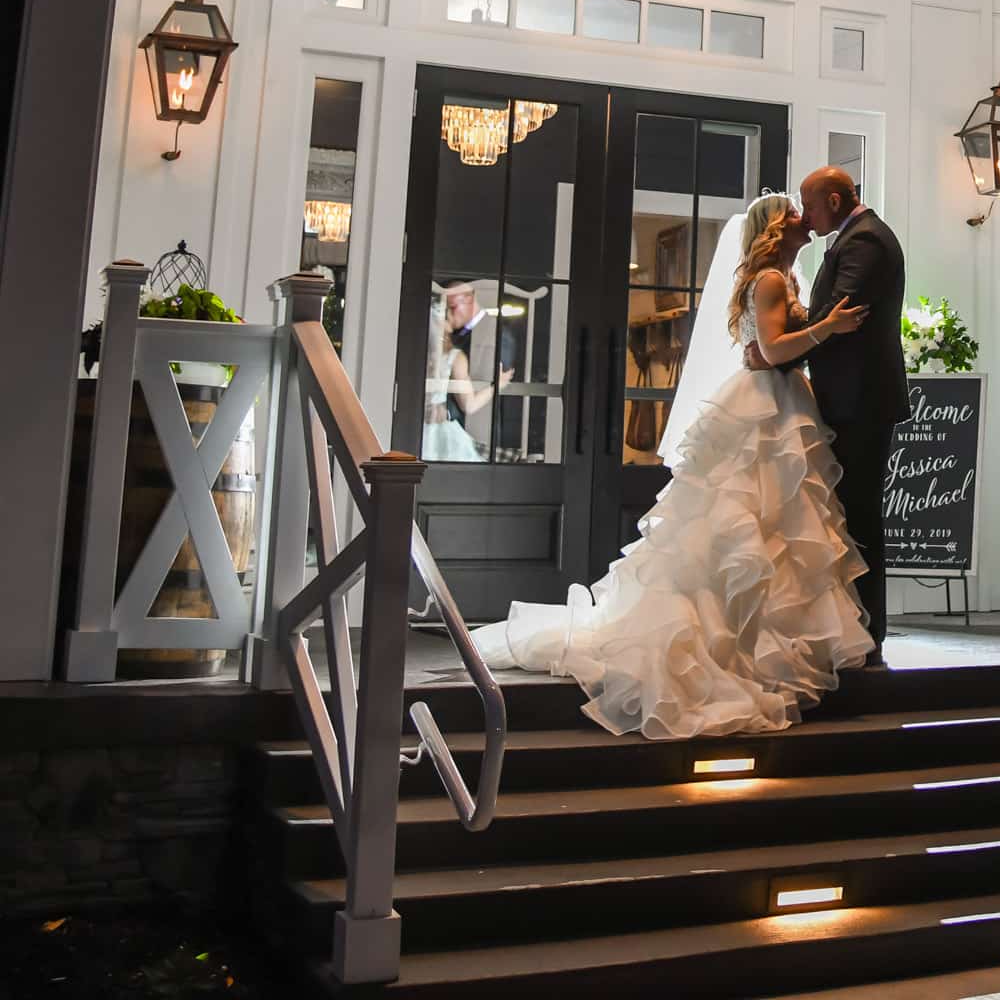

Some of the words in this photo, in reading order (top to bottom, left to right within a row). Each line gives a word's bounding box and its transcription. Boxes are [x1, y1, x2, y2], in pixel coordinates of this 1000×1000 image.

[897, 433, 934, 441] WEDDING
[937, 433, 947, 441] OF
[884, 447, 958, 492] Jessica
[883, 469, 974, 521] Michael
[929, 528, 952, 538] 2019
